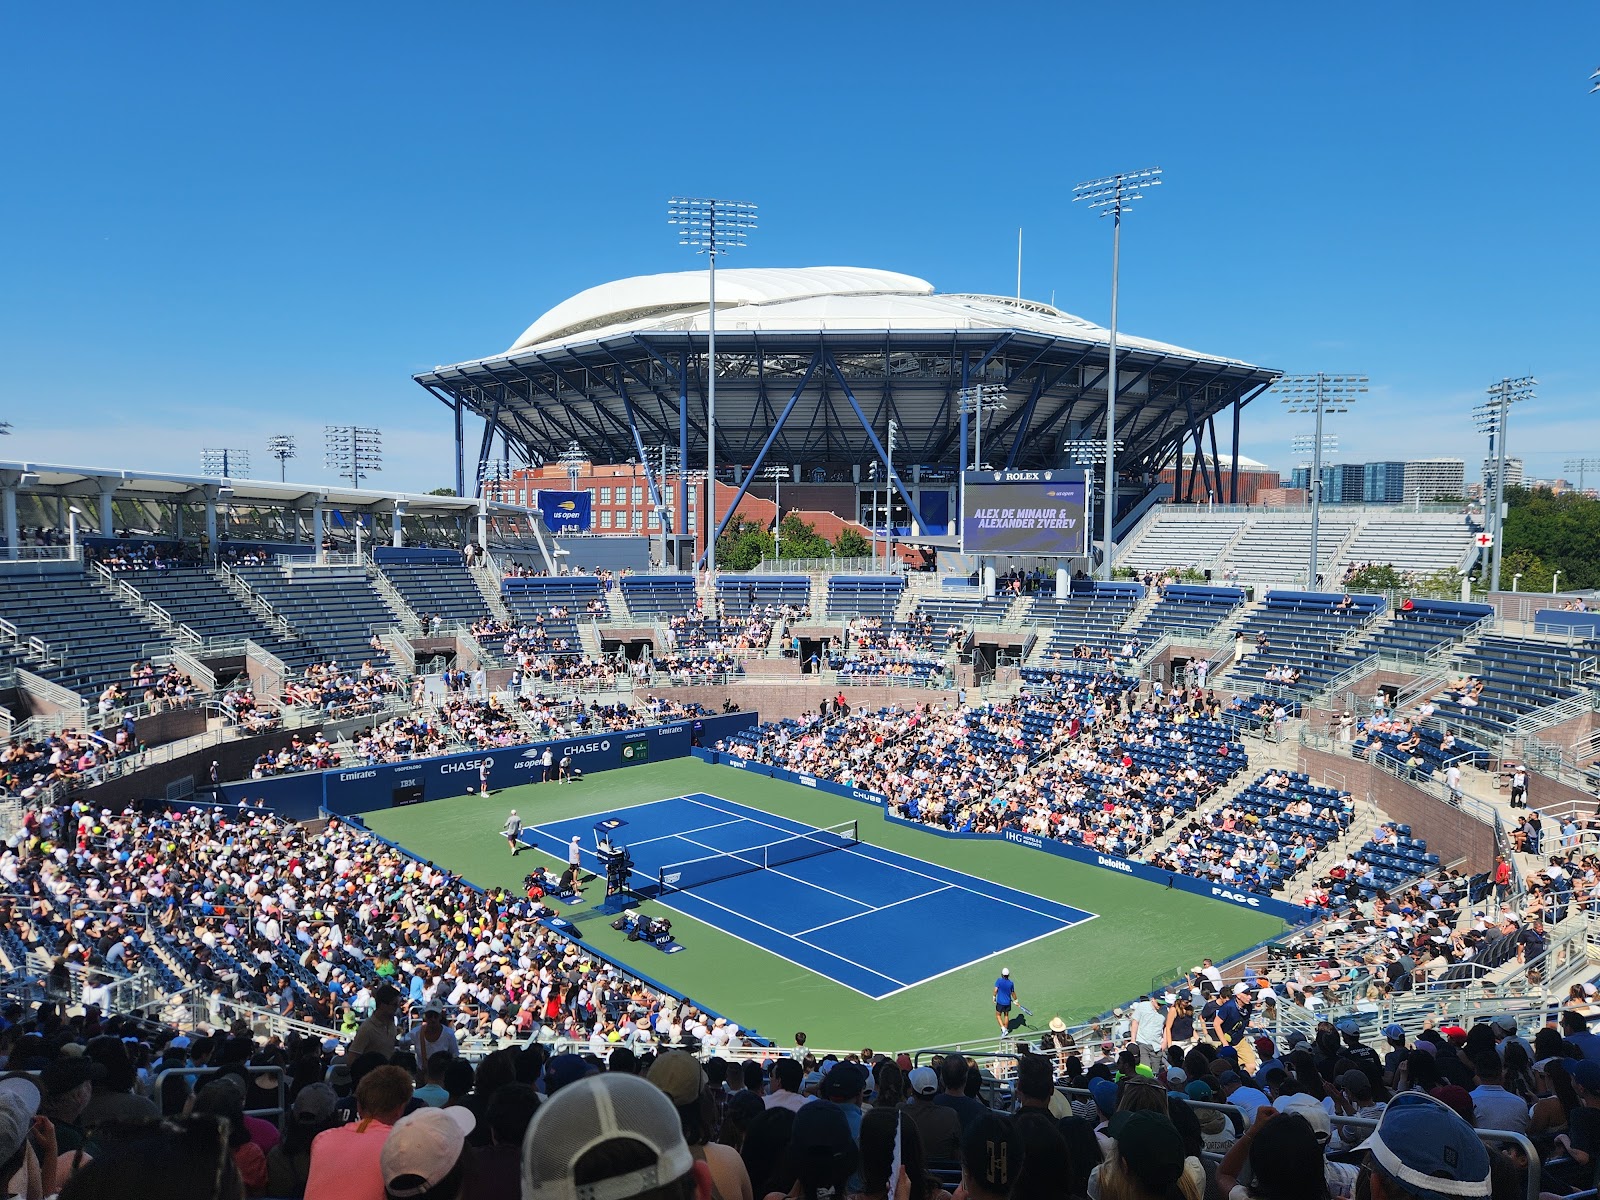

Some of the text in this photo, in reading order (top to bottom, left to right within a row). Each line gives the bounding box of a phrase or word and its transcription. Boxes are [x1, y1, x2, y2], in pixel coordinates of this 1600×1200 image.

[1006, 472, 1039, 481] ROLEX
[562, 512, 580, 520] open
[974, 508, 1066, 519] ALEX DE MINAUR &
[978, 518, 1076, 529] ALEXANDER ZVEREV
[658, 726, 683, 736] Emirates
[563, 742, 600, 756] CHASE
[440, 761, 482, 775] CHASE
[513, 758, 544, 769] us open
[340, 769, 377, 782] Emirates
[400, 778, 416, 788] IBM
[852, 790, 882, 804] CHUBB
[1005, 830, 1022, 843] IHG
[1098, 855, 1133, 873] Deloitte.
[1211, 887, 1260, 907] FAGE
[656, 934, 670, 945] POLO
